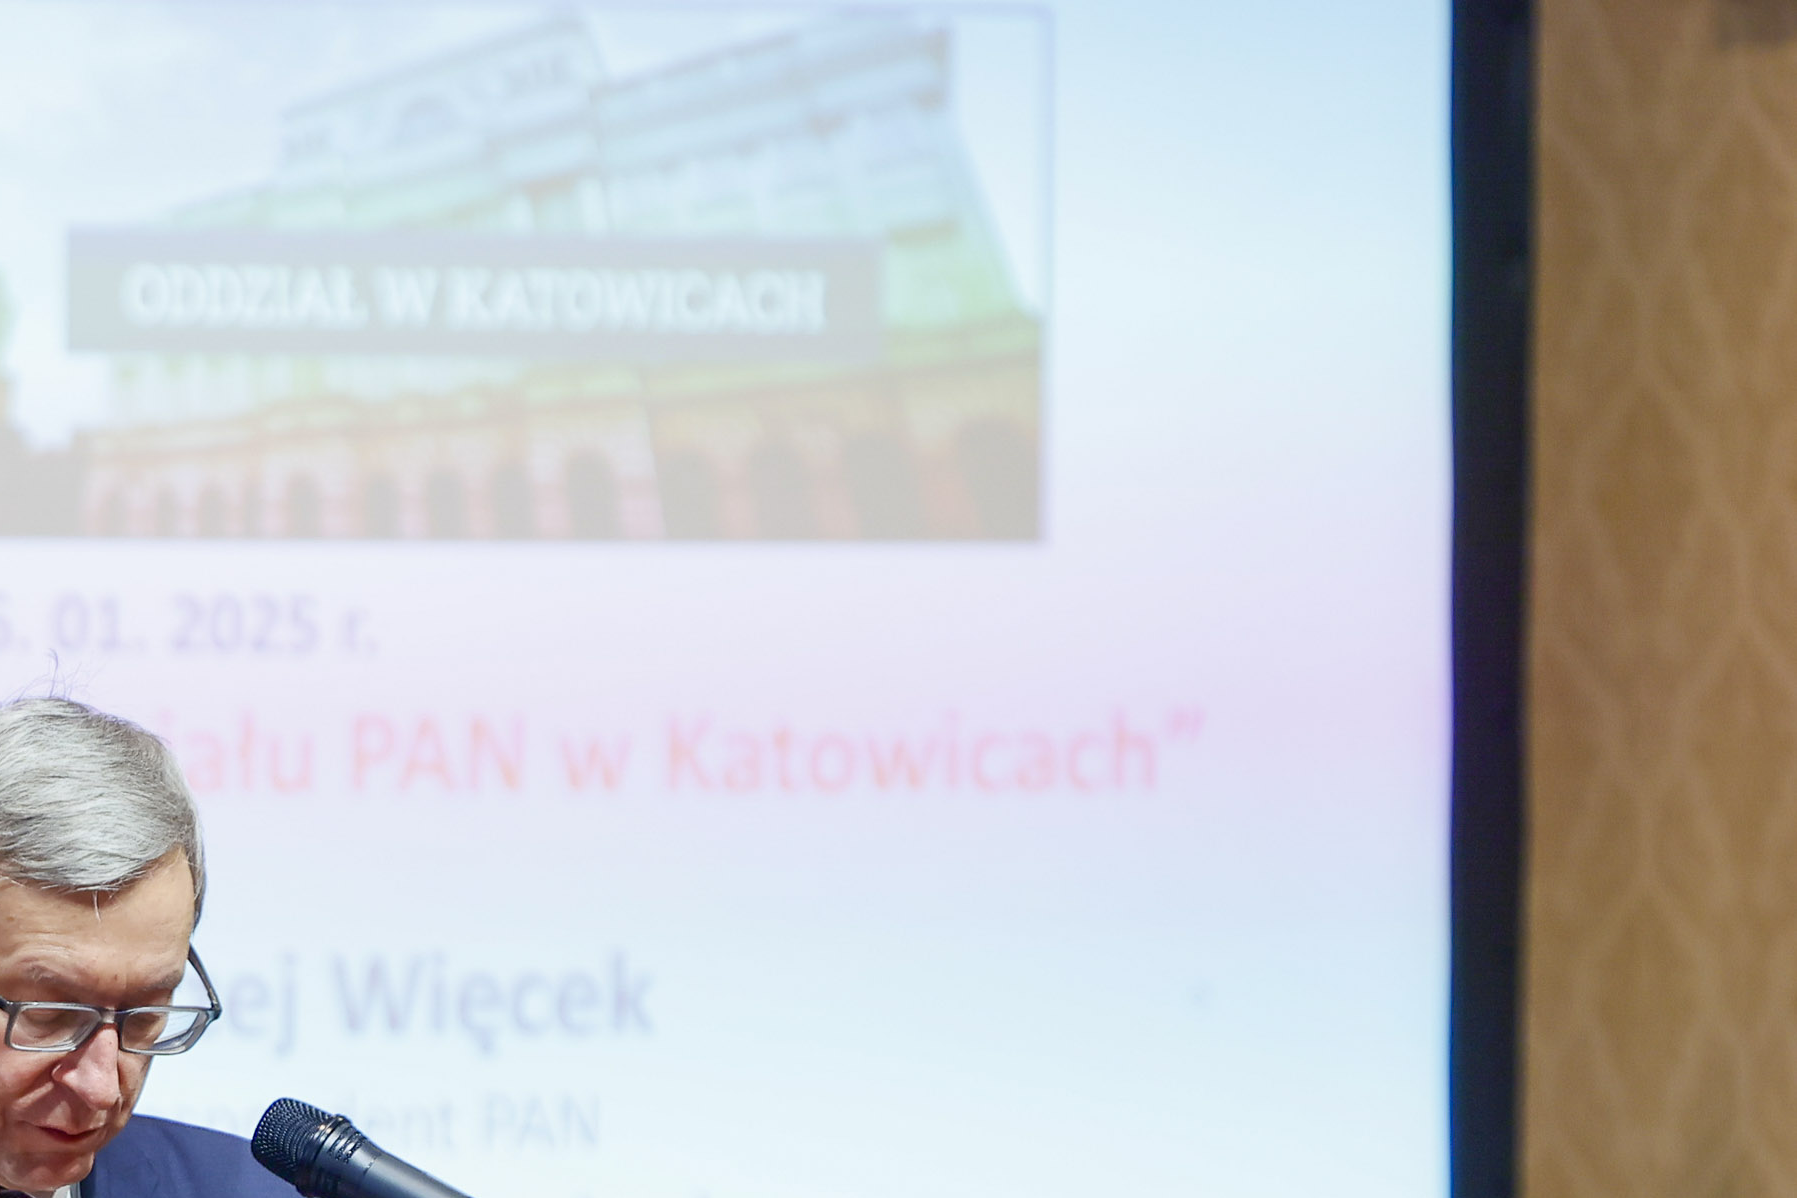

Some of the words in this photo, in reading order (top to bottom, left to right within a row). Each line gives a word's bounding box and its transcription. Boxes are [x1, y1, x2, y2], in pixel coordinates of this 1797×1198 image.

[374, 264, 439, 329] W
[445, 264, 828, 334] KATOWICACH
[49, 590, 147, 653] 01.
[169, 591, 320, 654] 2025
[337, 606, 379, 656] r.
[348, 708, 526, 794] PAN
[554, 727, 633, 794] w
[330, 947, 657, 1061] Więcek
[482, 1092, 602, 1148] PAN
